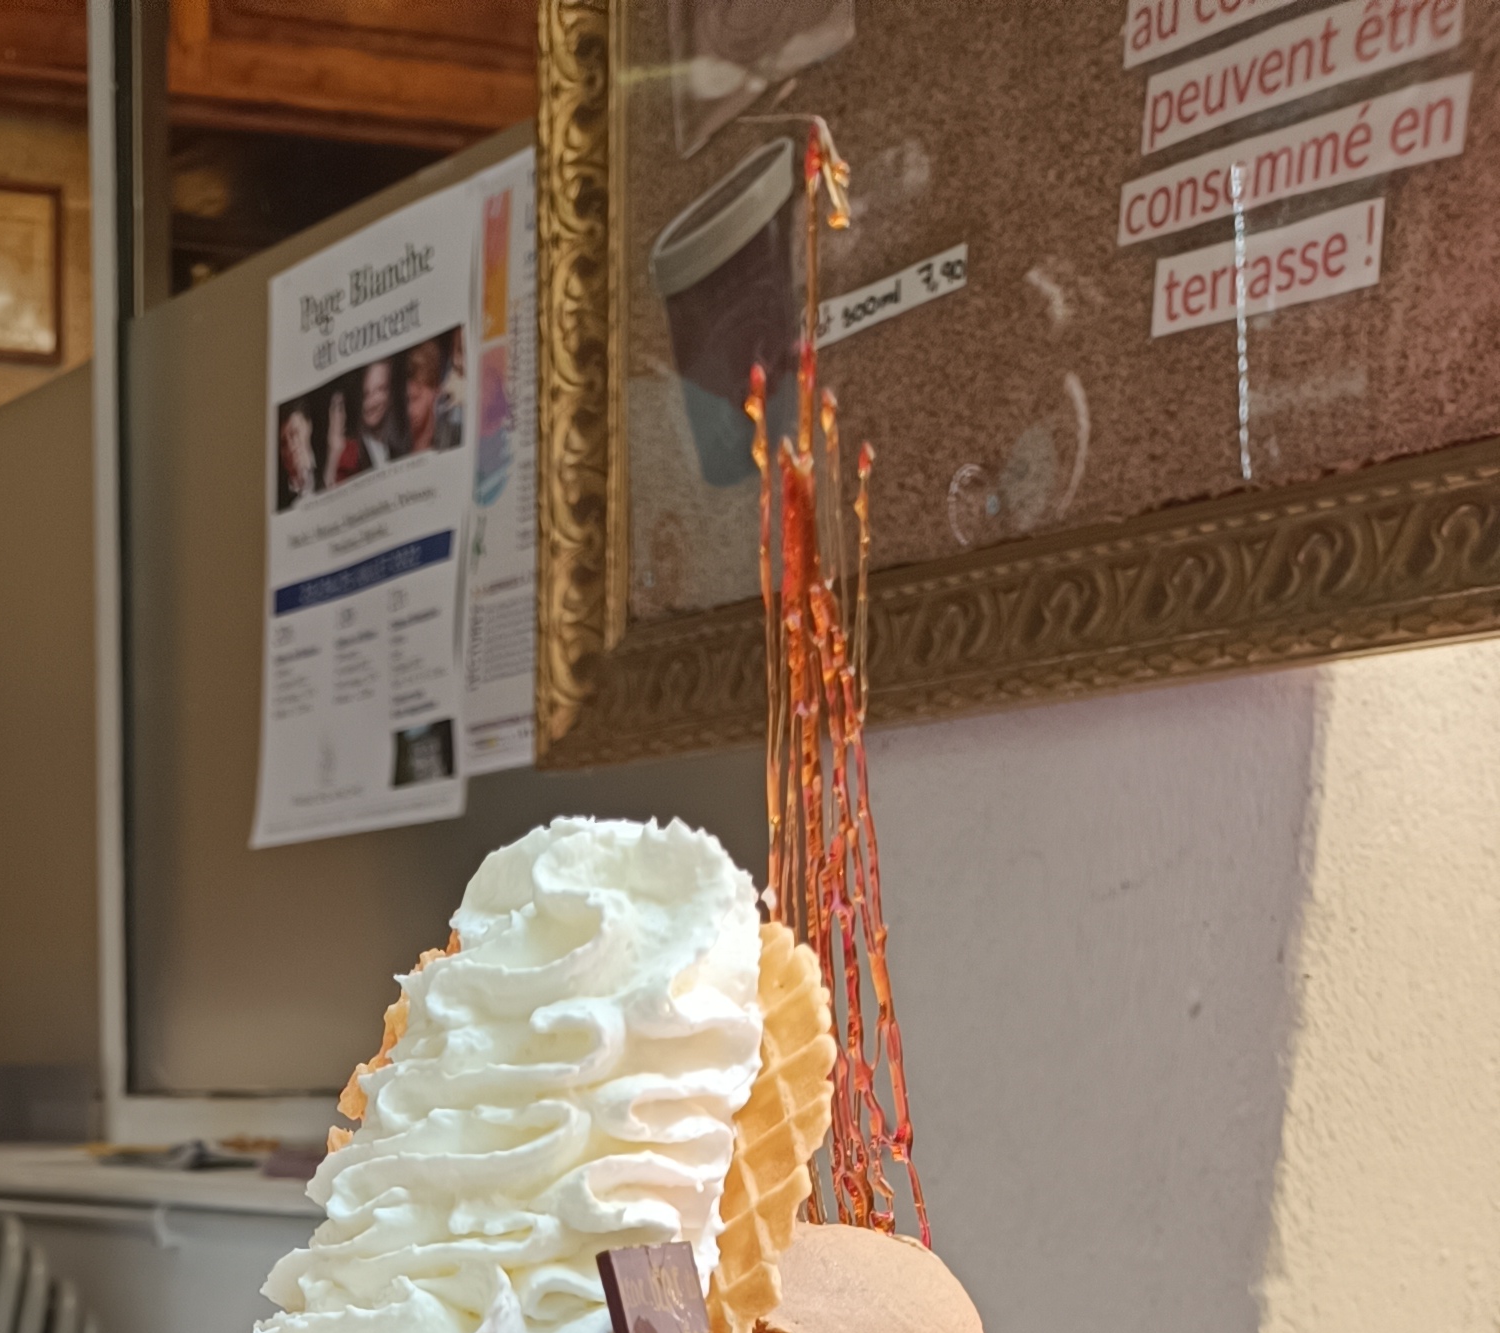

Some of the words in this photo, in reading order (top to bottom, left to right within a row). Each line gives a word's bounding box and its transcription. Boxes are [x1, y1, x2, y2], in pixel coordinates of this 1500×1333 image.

[1131, 0, 1180, 51] au
[1149, 17, 1340, 149] peuvent
[1354, 0, 1457, 63] être
[1389, 96, 1456, 156] en
